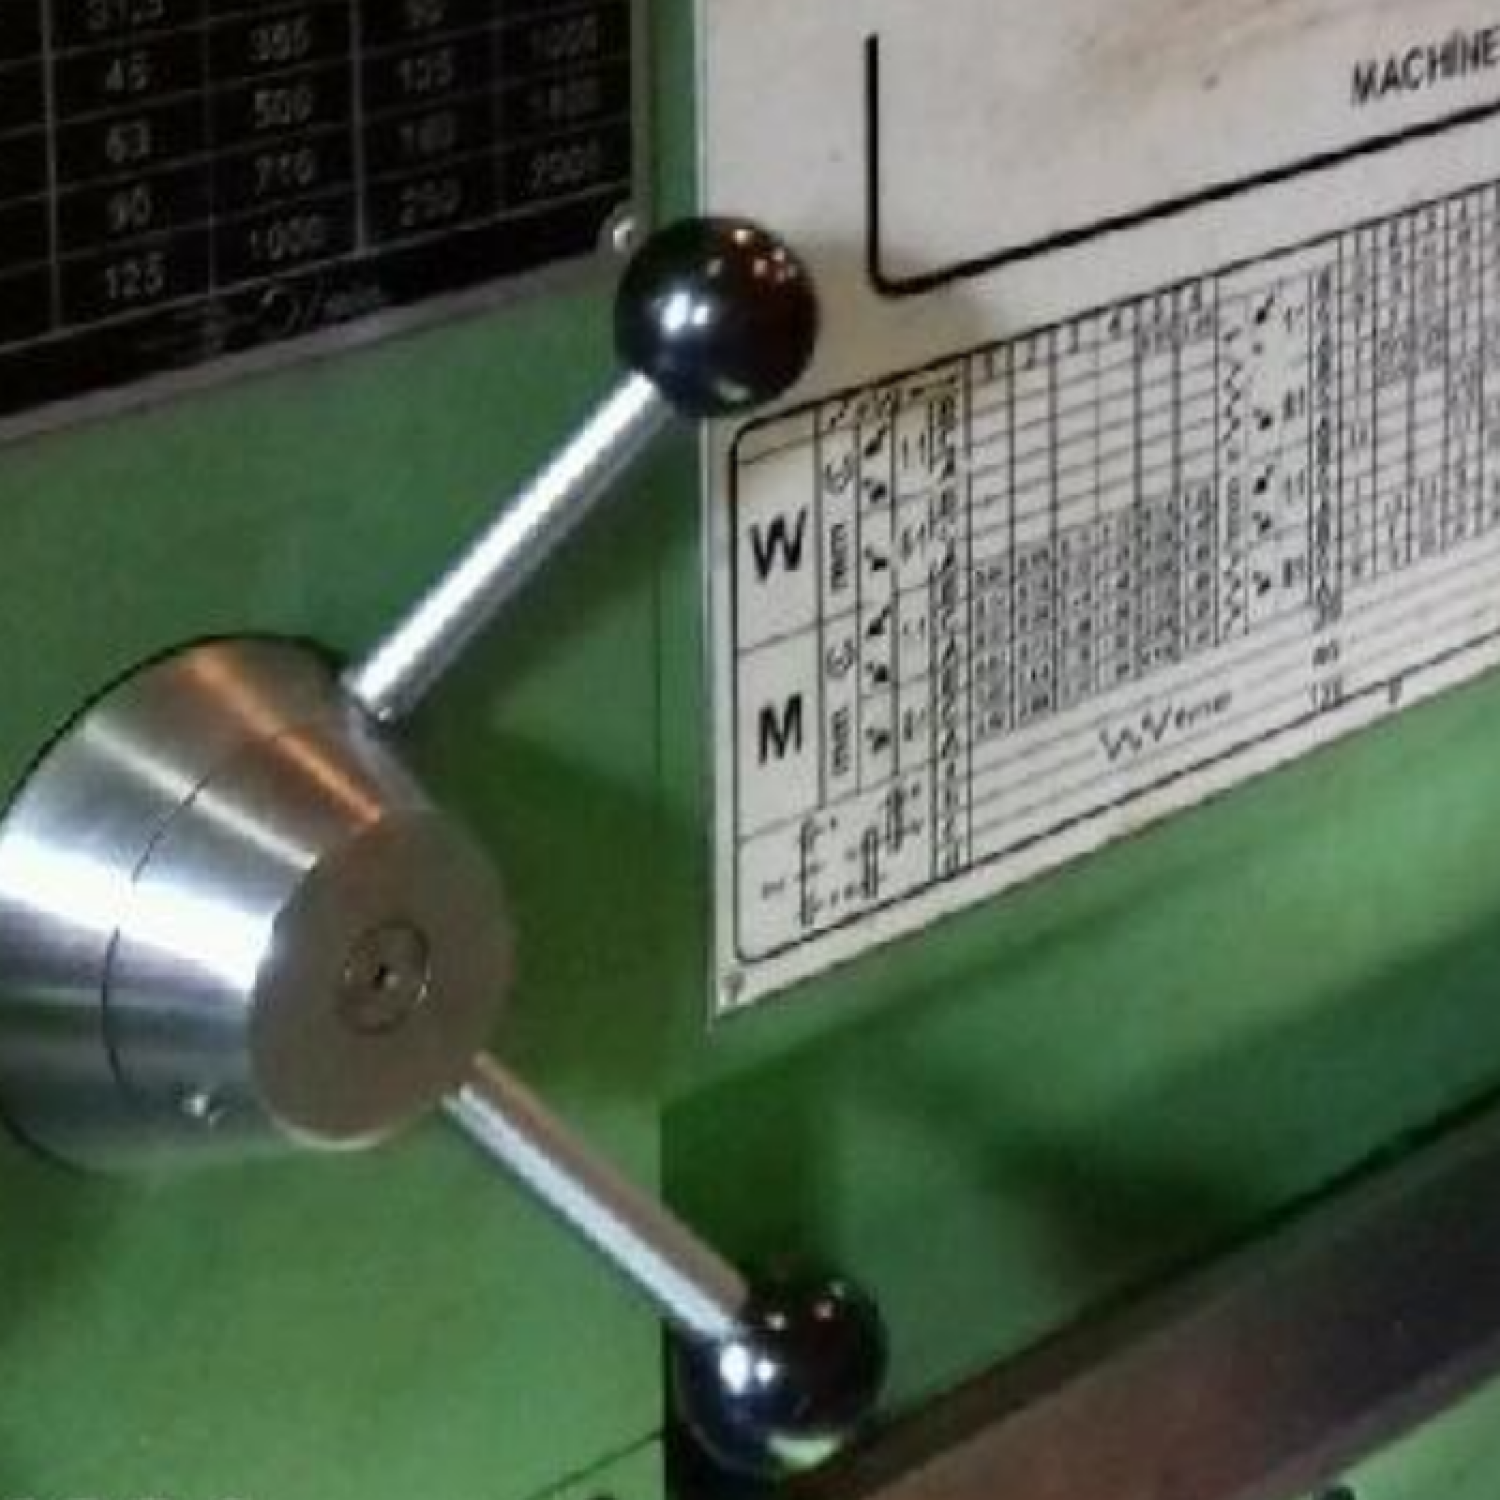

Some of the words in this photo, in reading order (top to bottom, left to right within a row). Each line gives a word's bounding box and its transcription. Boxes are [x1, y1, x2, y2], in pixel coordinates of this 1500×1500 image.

[1350, 24, 1500, 107] MACHINE
[751, 508, 808, 584] W
[757, 692, 804, 766] M
